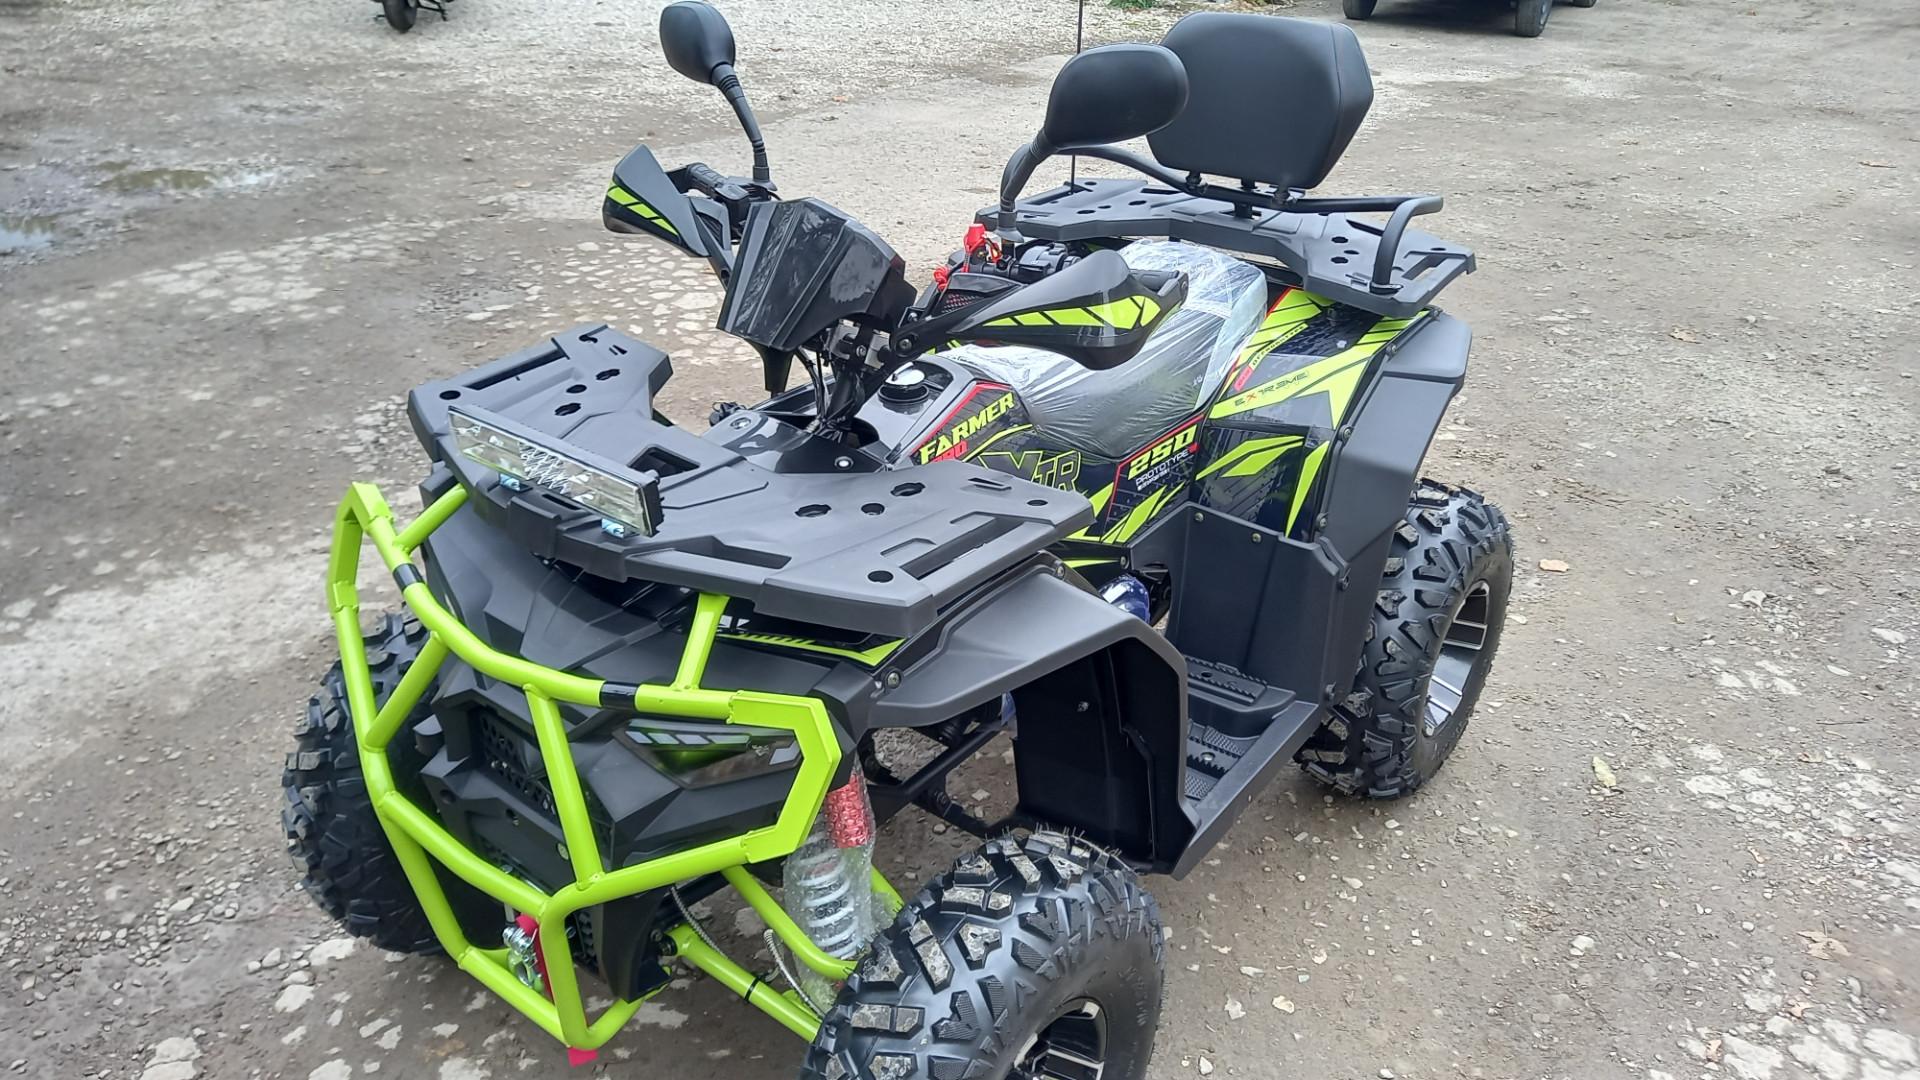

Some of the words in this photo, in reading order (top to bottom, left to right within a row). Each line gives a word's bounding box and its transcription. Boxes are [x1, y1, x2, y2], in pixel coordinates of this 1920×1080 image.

[919, 392, 1015, 465] FARMER
[1127, 424, 1197, 480] 250
[1135, 449, 1189, 487] PROTOTYPE
